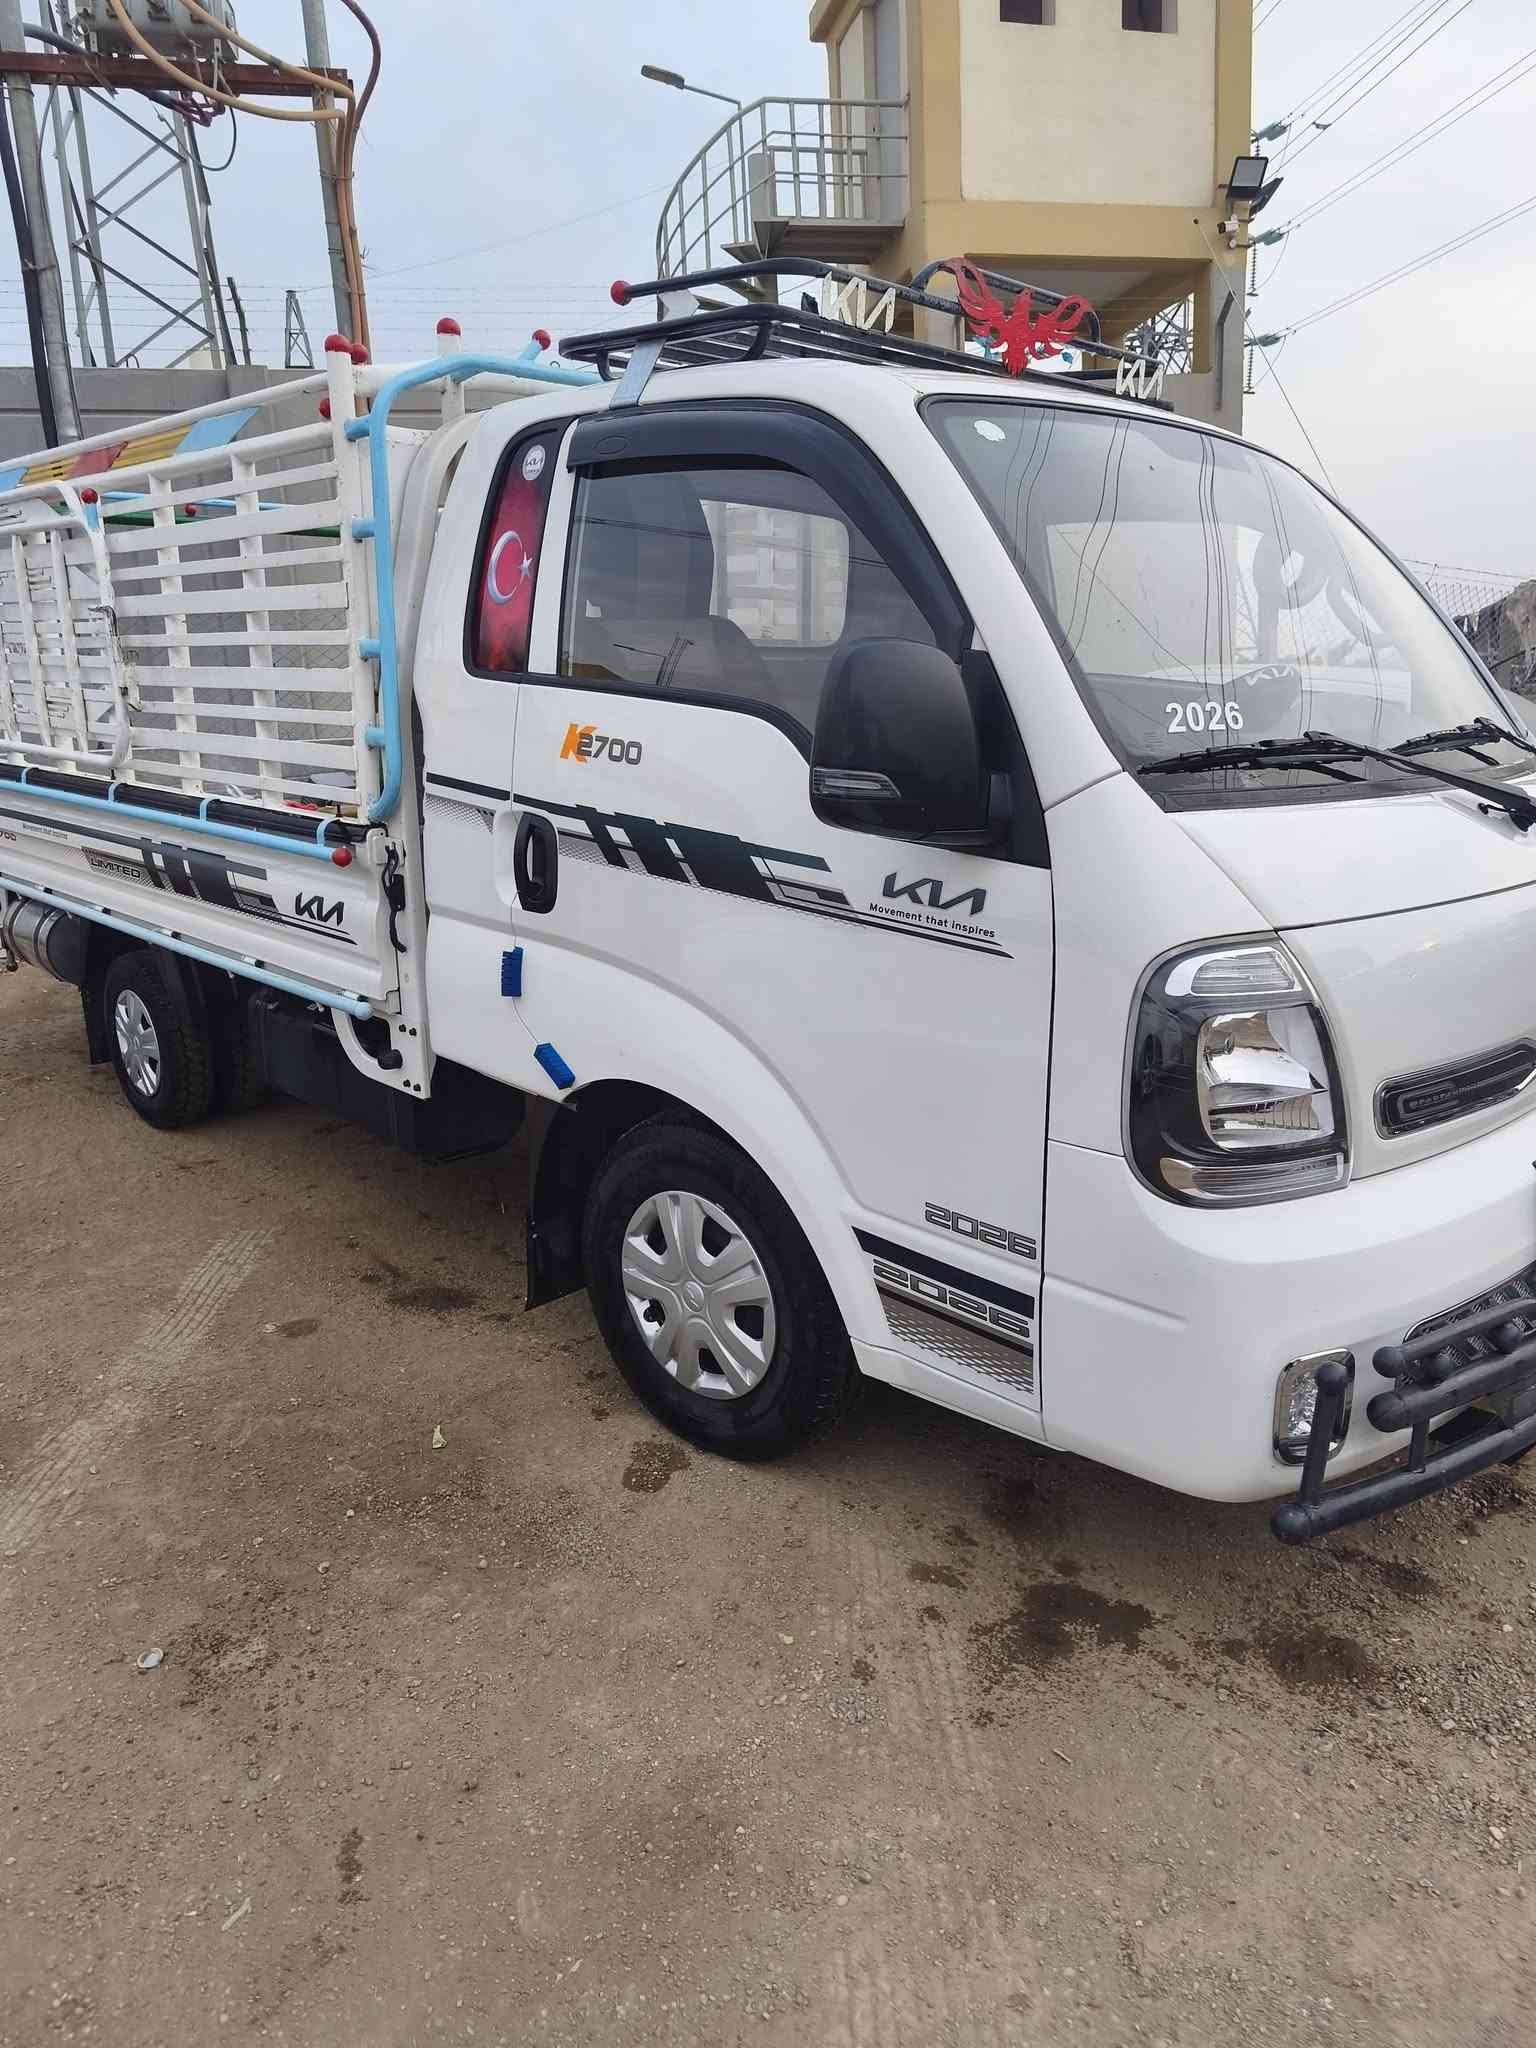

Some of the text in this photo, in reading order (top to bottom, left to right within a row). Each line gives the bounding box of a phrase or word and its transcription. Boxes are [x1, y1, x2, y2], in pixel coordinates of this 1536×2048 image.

[822, 271, 896, 333] KIA
[1115, 357, 1166, 400] KIA
[1165, 701, 1244, 734] 2026
[560, 723, 642, 766] K2700
[89, 857, 141, 879] LIMITED
[295, 892, 345, 926] KIA
[882, 872, 987, 916] KIA
[869, 902, 996, 939] Movement that inspires
[924, 1202, 1037, 1260] 2026
[872, 1258, 1030, 1338] 2026
